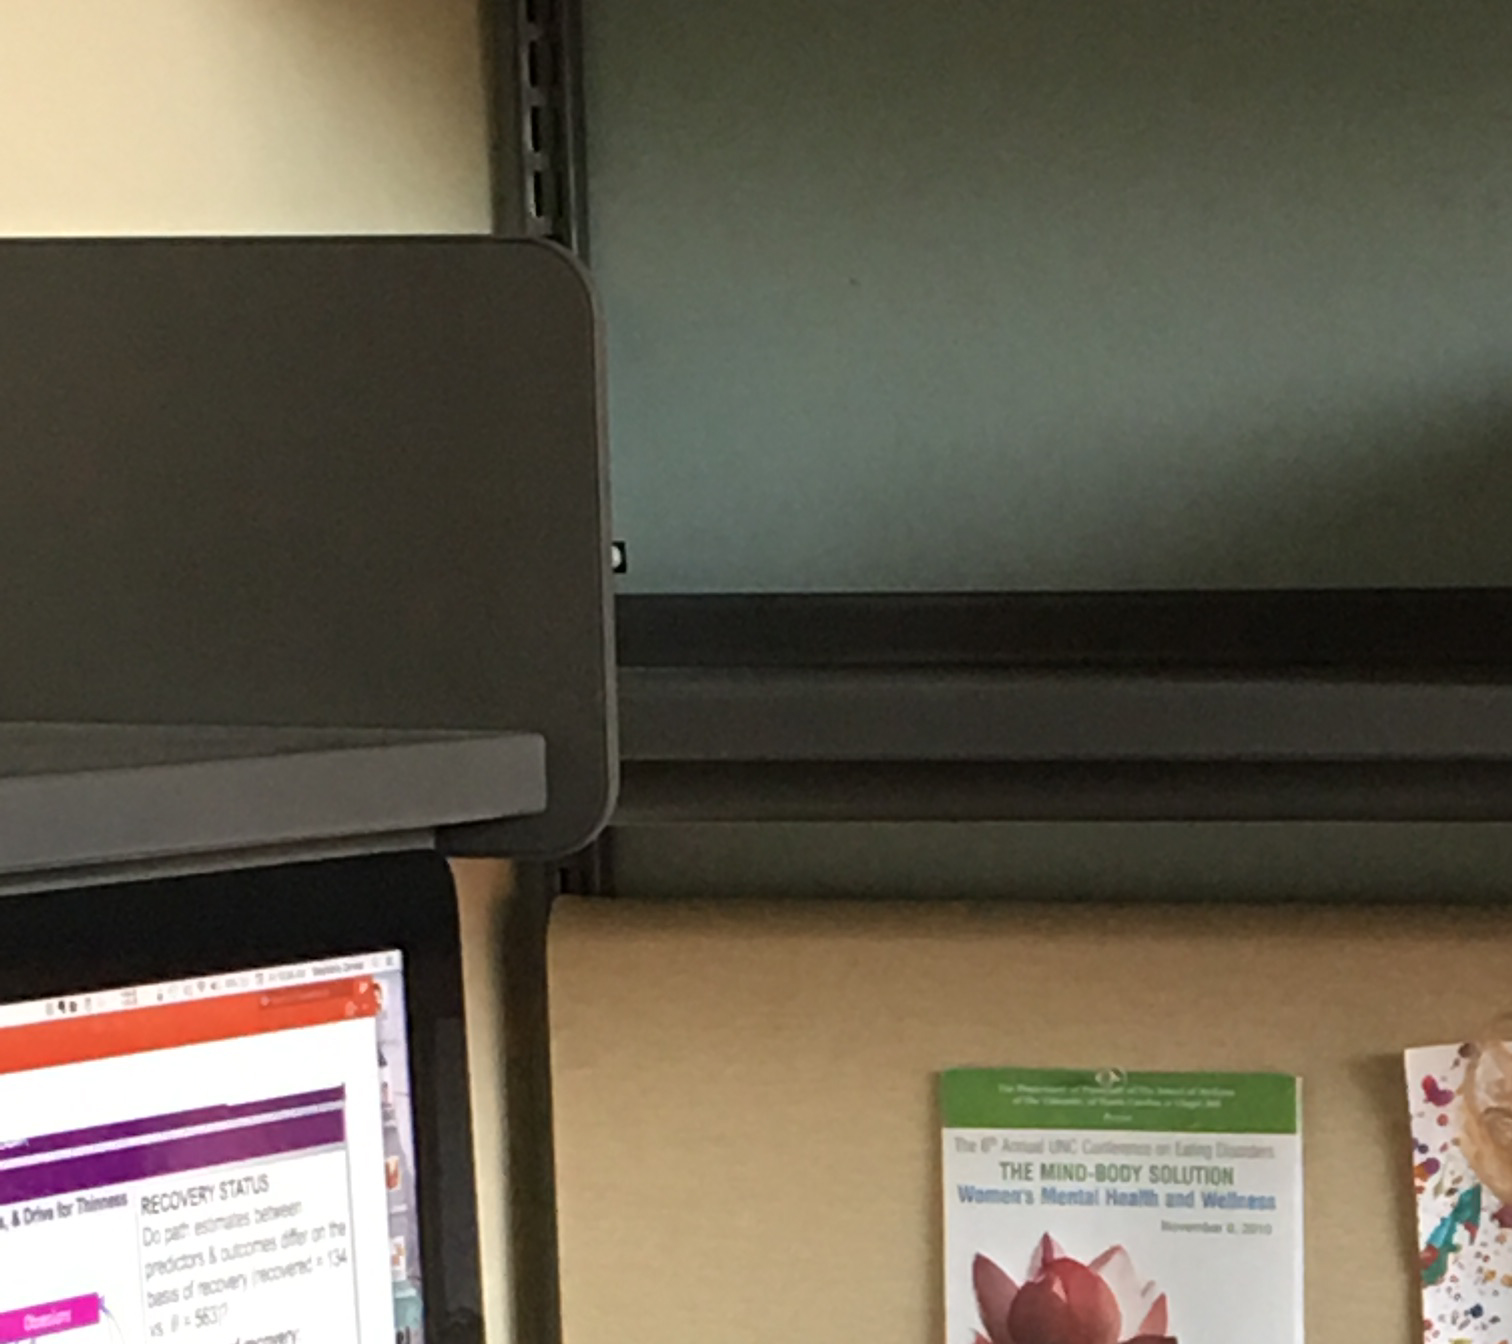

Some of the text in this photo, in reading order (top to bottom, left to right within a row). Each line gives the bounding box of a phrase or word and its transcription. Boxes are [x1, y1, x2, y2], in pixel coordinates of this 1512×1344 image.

[954, 1137, 976, 1153] The
[1002, 1138, 1044, 1154] Annual
[1049, 1138, 1078, 1155] UNC
[1156, 1143, 1170, 1156] on
[1175, 1141, 1212, 1160] Eating
[1216, 1142, 1275, 1159] Disorders
[999, 1162, 1234, 1186] THE MIND-BODY SOLUTION
[141, 1173, 270, 1216] RECOVERY STATUS
[957, 1184, 1276, 1210] Women's Mental Health and Wellness
[23, 1206, 54, 1225] Drive
[56, 1200, 72, 1219] for
[142, 1226, 161, 1247] Do
[164, 1222, 190, 1246] path
[254, 1201, 302, 1224] between
[1161, 1220, 1222, 1234] November
[220, 1237, 277, 1262] outcomes
[328, 1221, 346, 1238] the
[182, 1280, 194, 1301] of
[198, 1273, 248, 1296] recovery
